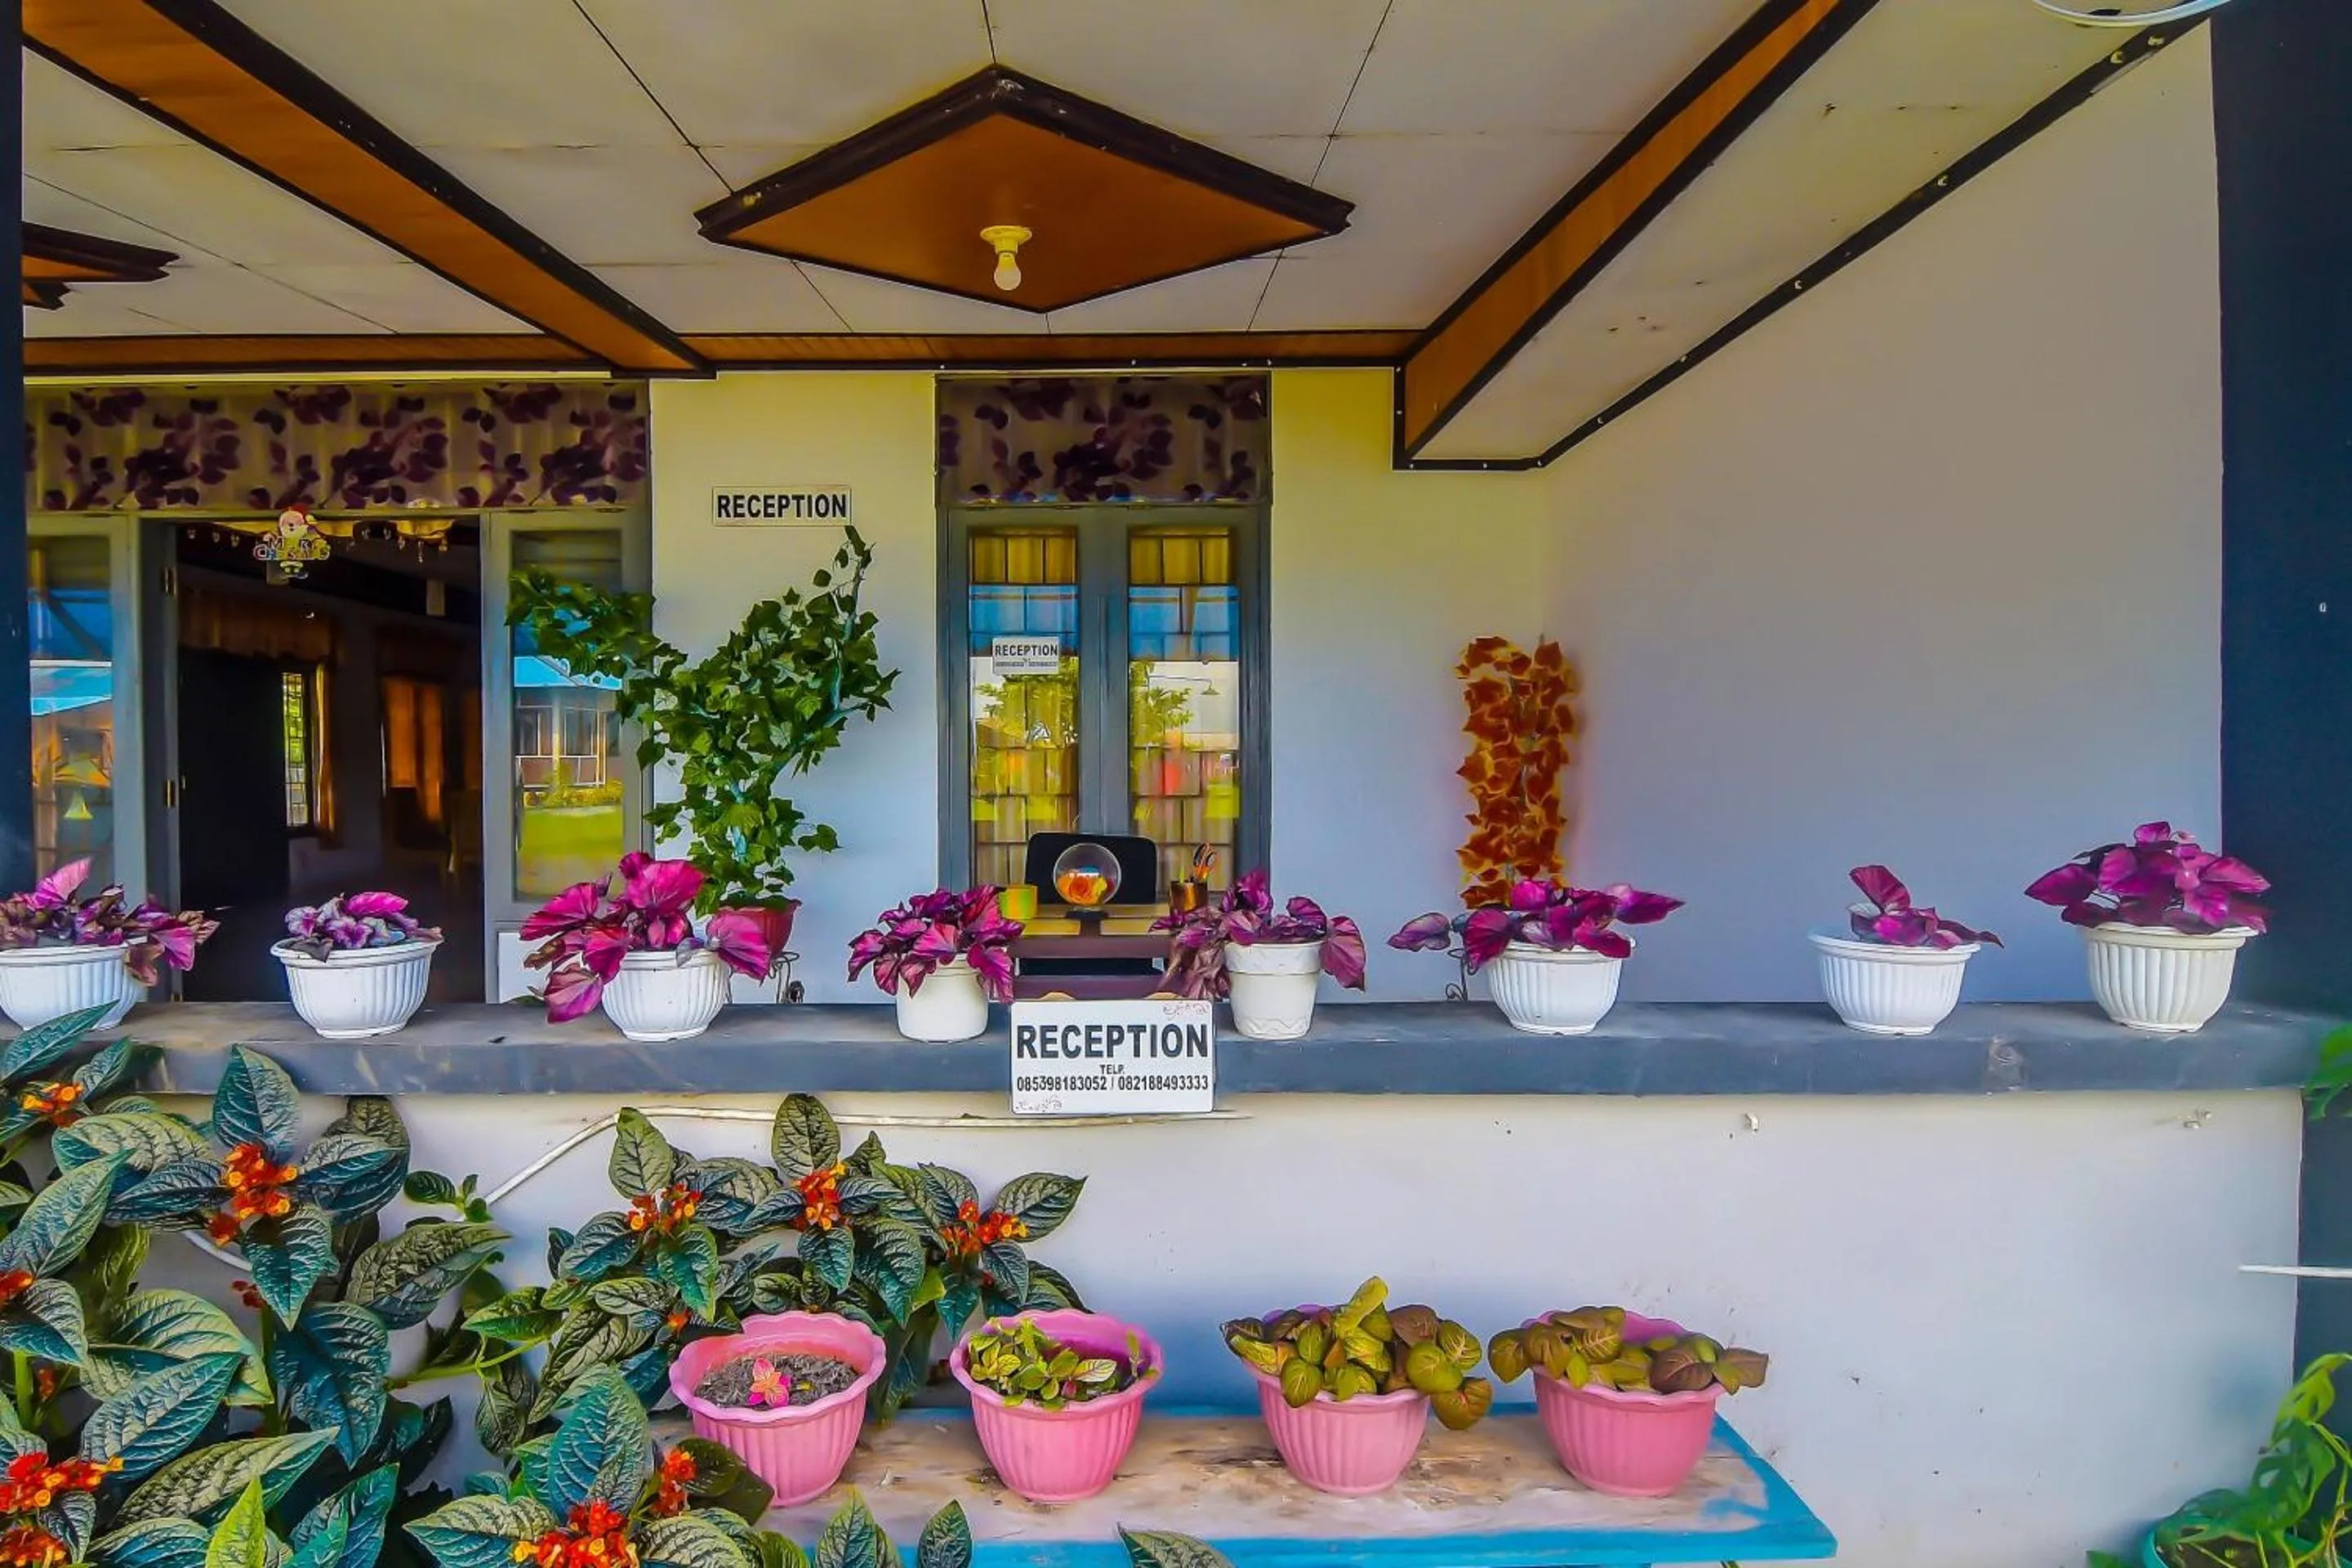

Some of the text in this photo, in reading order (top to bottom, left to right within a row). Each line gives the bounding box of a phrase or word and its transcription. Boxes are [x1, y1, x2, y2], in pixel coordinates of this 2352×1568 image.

[717, 493, 846, 519] RECEPTION
[995, 643, 1058, 657] RECEPTION
[1016, 1023, 1209, 1059] RECEPTION
[1017, 1075, 1107, 1092] 085398183052
[1117, 1075, 1209, 1091] 082188493333
